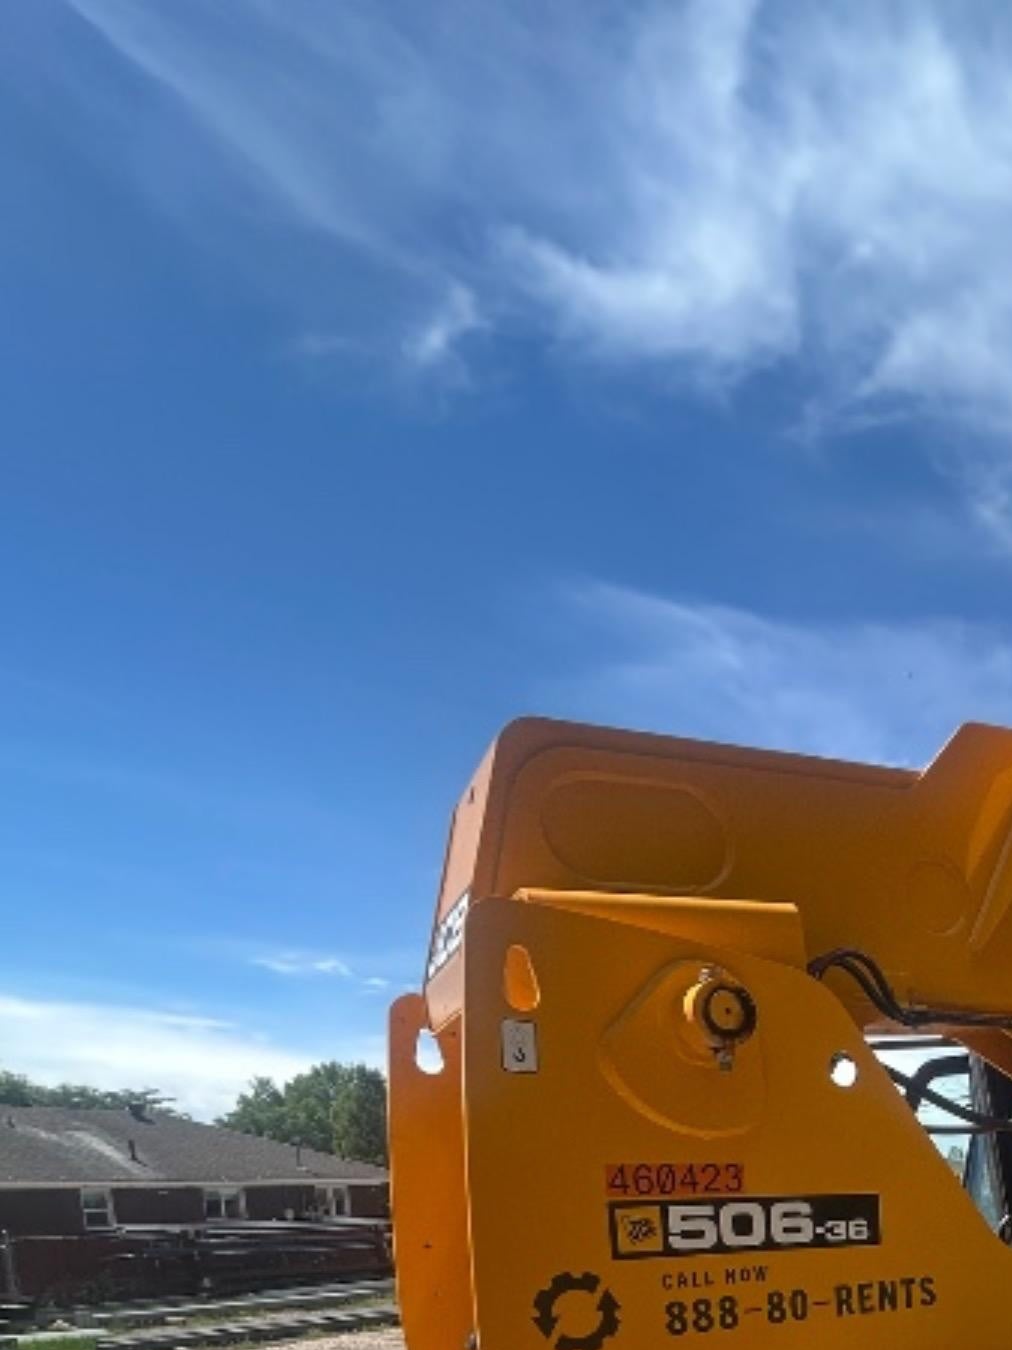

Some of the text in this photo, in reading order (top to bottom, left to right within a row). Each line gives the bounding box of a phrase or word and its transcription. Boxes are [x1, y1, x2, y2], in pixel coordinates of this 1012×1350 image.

[608, 1163, 744, 1195] 460423
[667, 1201, 869, 1249] 506-36
[661, 1265, 769, 1290] CALL NOW
[665, 1277, 937, 1336] 888-80-RENTS
